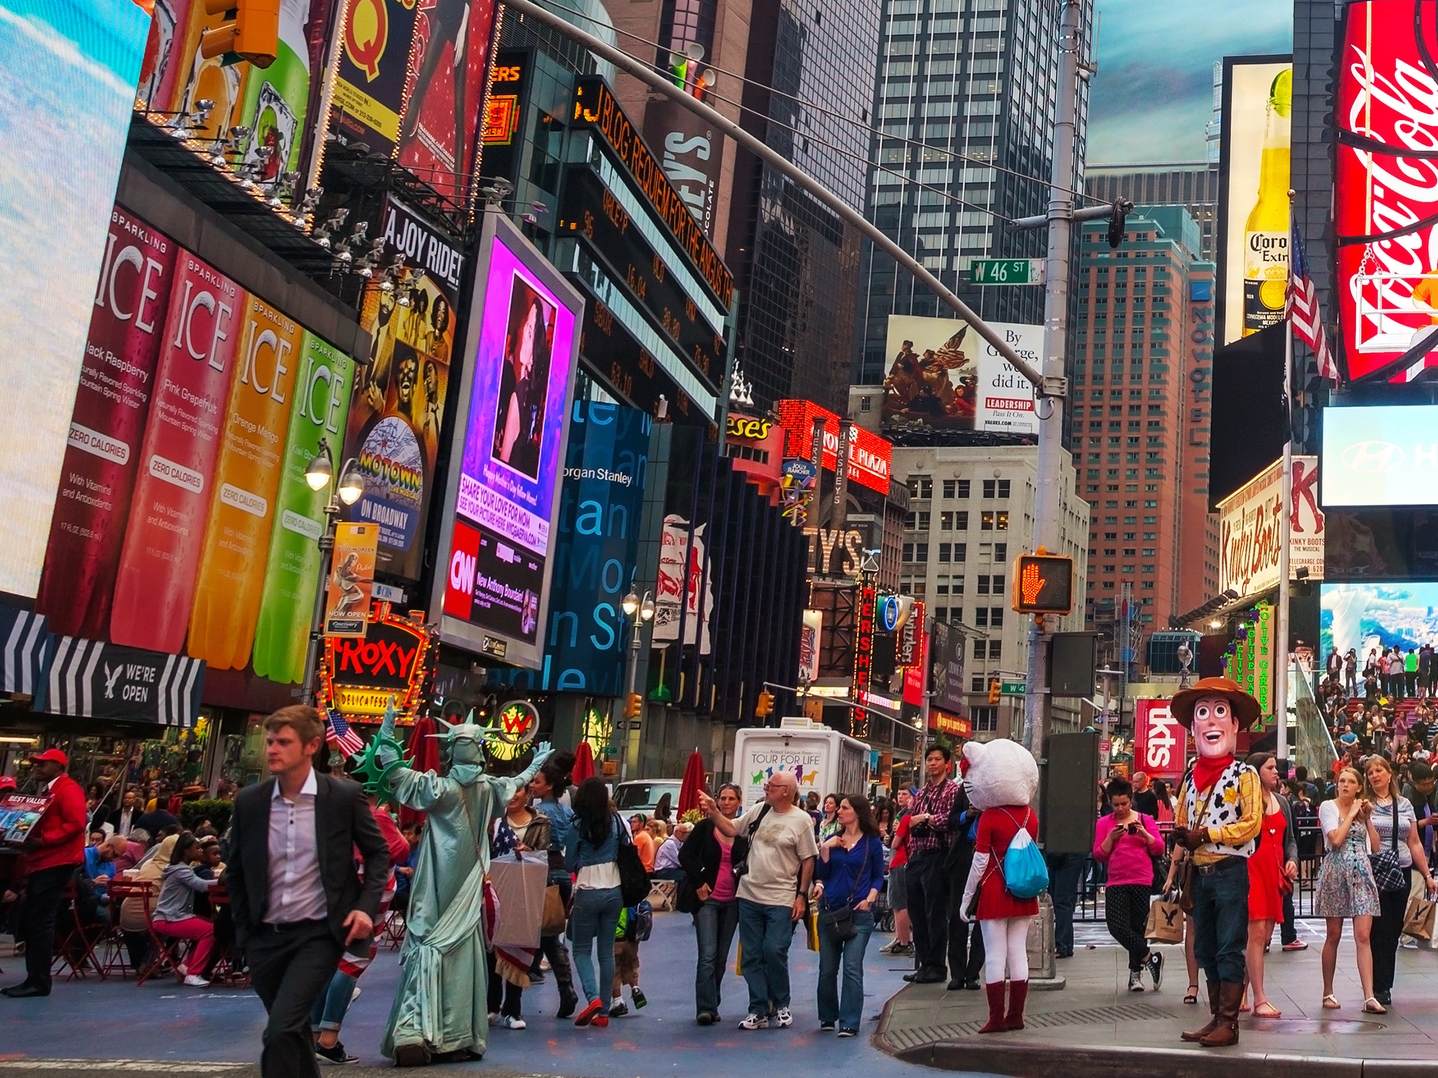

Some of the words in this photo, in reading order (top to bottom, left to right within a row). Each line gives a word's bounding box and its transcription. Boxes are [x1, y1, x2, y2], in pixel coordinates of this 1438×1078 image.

[631, 140, 671, 209] REQUIEM
[670, 202, 687, 236] FOR
[685, 215, 702, 264] THE
[112, 210, 167, 255] SPARKLING
[95, 232, 164, 335] ICE
[187, 259, 236, 298] SPARKLING
[975, 263, 986, 282] W
[990, 262, 1008, 282] 46
[1013, 262, 1025, 272] ST
[173, 279, 233, 374] ICE
[252, 301, 296, 335] SPARKLING
[310, 339, 348, 370] SPARKLING
[1006, 330, 1022, 346] By
[240, 319, 293, 406] ICE
[163, 378, 180, 399] Pink
[181, 387, 218, 416] Grapefruit
[300, 356, 346, 436] ICE
[992, 375, 1013, 389] did
[1017, 375, 1029, 389] it.
[987, 398, 1031, 410] LEADERSHIP
[69, 427, 91, 446] ZERO
[91, 436, 126, 460] CALORIES
[152, 460, 170, 477] ZERO
[171, 467, 201, 489] CALORIES
[360, 449, 421, 493] MOTOWN
[597, 467, 632, 487] Stanley
[860, 449, 887, 474] PLAZA
[223, 487, 238, 502] ZERO
[239, 493, 265, 513] CALORIES
[361, 499, 372, 519] ON
[372, 503, 409, 530] BROADWAY
[460, 477, 479, 499] SHARE
[479, 485, 495, 507] YOUR
[495, 494, 508, 516] LOVE
[507, 502, 519, 521] FOR
[519, 508, 531, 529] MOM
[451, 550, 476, 595] CNN
[1260, 611, 1270, 655] OLIVE
[126, 663, 156, 684] WE'RE
[1259, 660, 1268, 712] GARDEN
[122, 684, 149, 703] OPEN
[1147, 706, 1178, 768] tkts
[752, 754, 778, 764] TOUR
[781, 754, 800, 765] FOR
[803, 756, 820, 765] LIFE
[8, 795, 26, 803] BEST
[26, 797, 47, 805] VALUE
